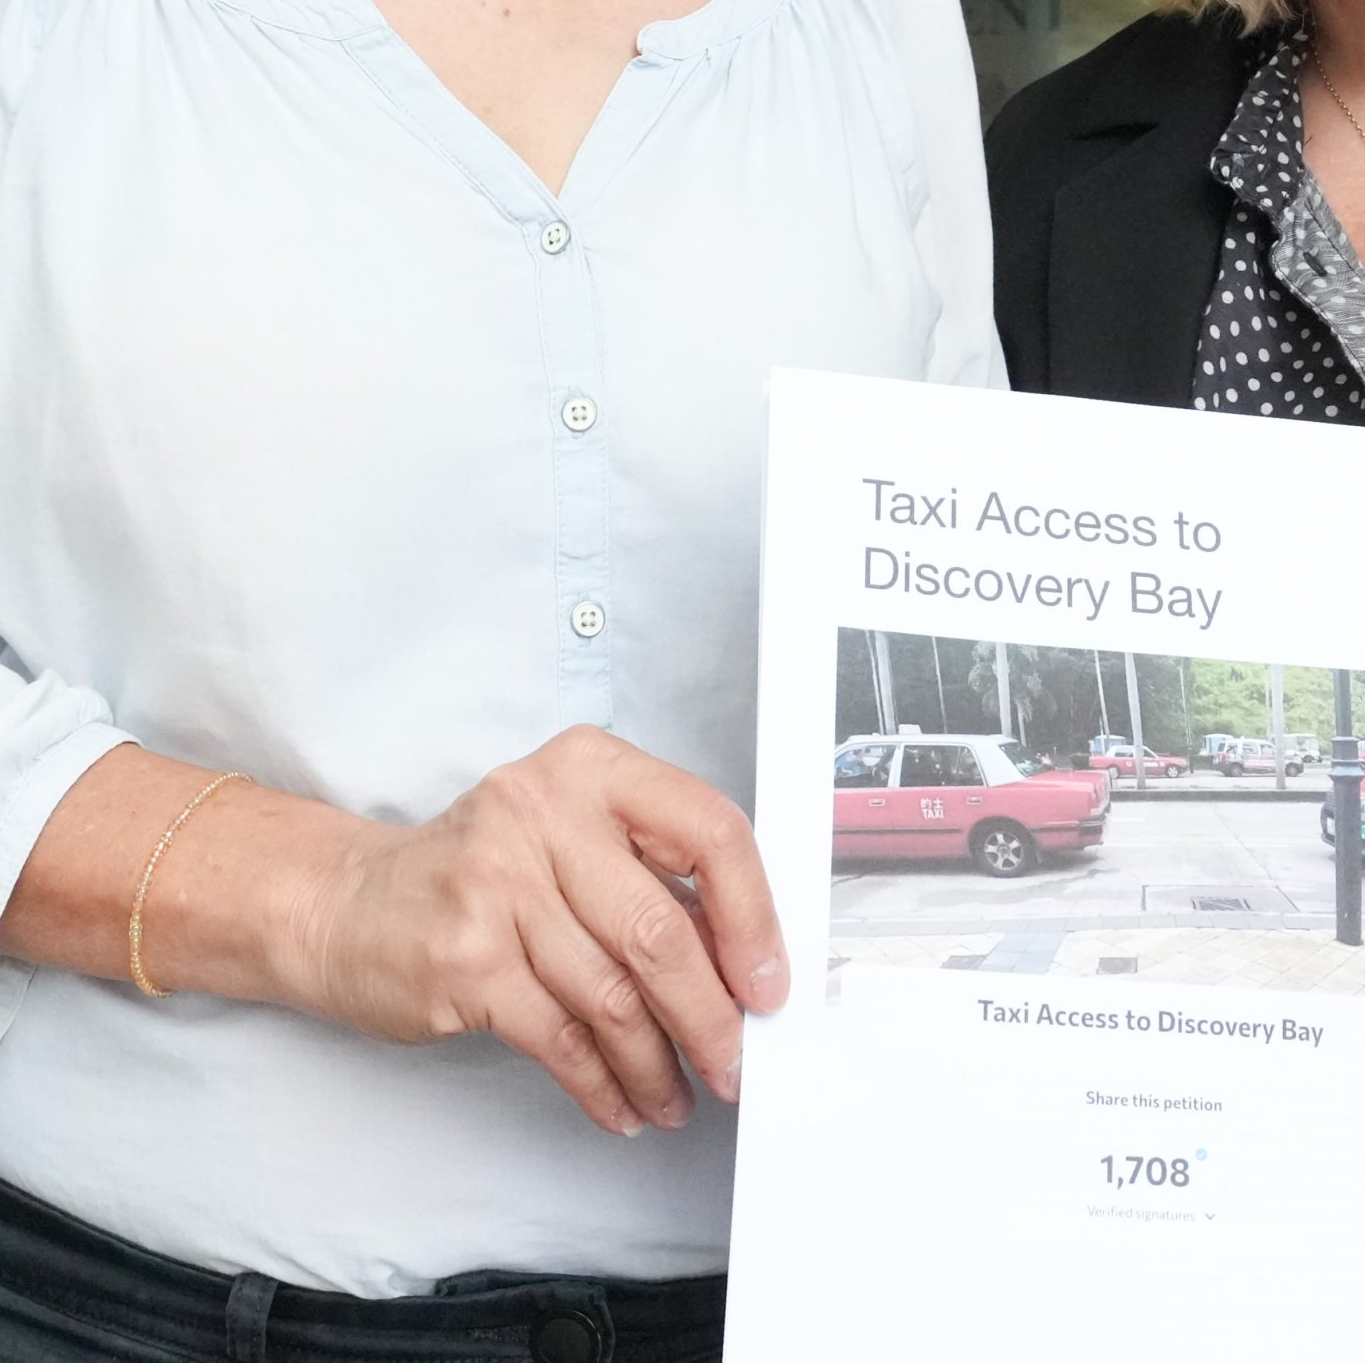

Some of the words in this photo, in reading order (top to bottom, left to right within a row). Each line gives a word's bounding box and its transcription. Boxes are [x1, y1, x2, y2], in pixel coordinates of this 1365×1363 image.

[862, 478, 958, 529] Taxi
[975, 491, 1158, 547] Access
[1173, 511, 1222, 553] to
[863, 546, 1110, 621] Discovery
[1130, 571, 1223, 630] Bay
[921, 808, 945, 820] TAXI
[977, 999, 1030, 1024] Taxi
[1035, 1003, 1120, 1030] Access
[1125, 1009, 1152, 1032] to
[1158, 1010, 1276, 1045] Discovery
[1281, 1018, 1324, 1048] Bay
[1086, 1090, 1129, 1107] Share
[1133, 1093, 1160, 1110] this
[1163, 1096, 1223, 1113] petition
[1100, 1154, 1191, 1191] 1,708
[1086, 1204, 1133, 1219] Verified
[1135, 1206, 1196, 1223] signatures
